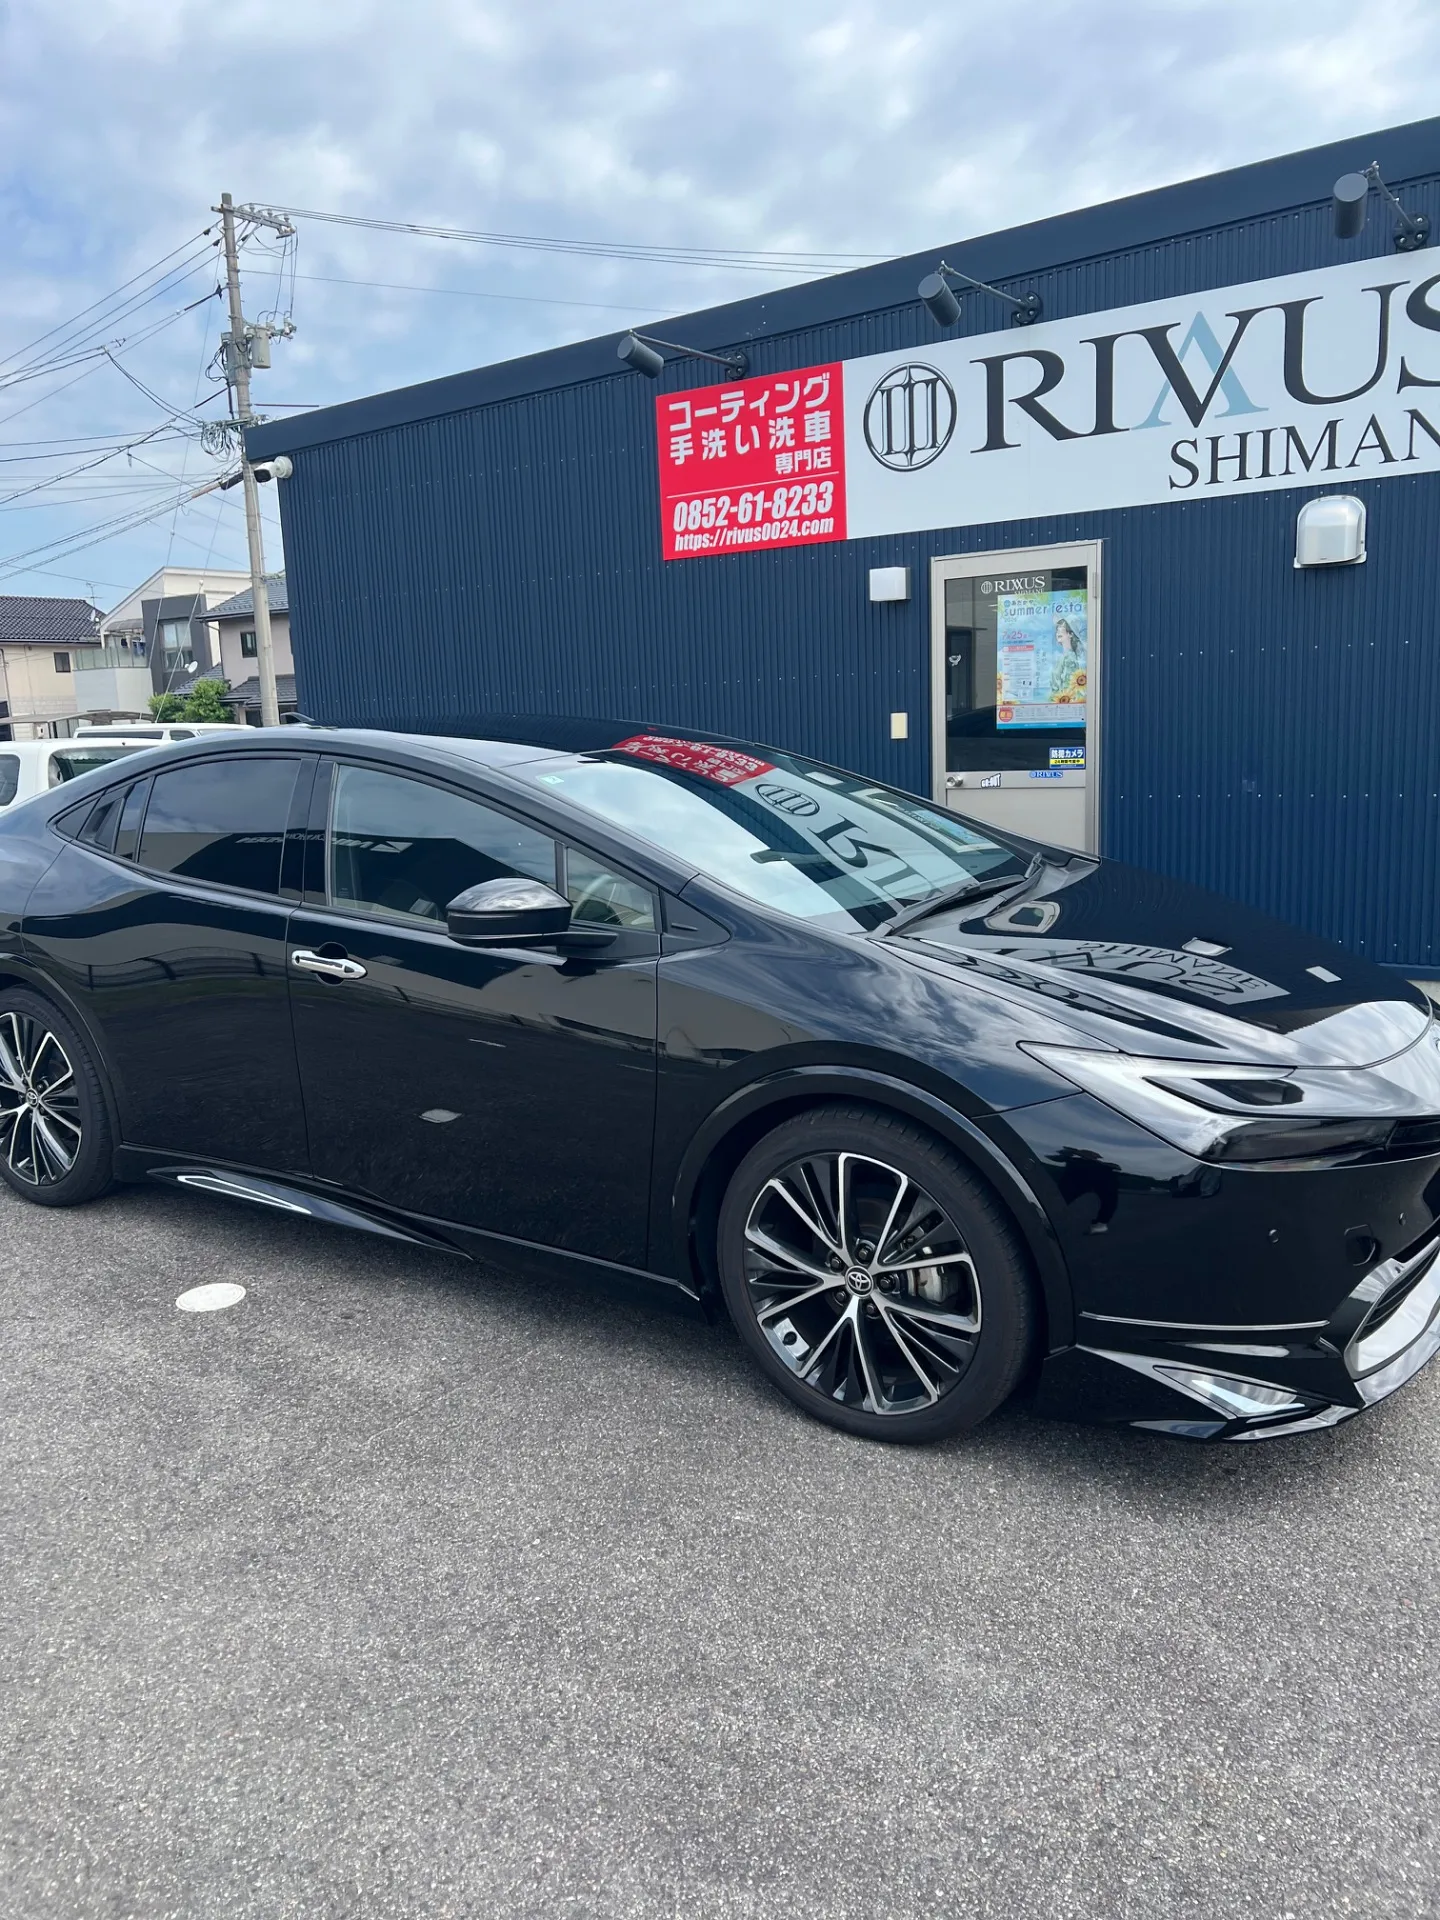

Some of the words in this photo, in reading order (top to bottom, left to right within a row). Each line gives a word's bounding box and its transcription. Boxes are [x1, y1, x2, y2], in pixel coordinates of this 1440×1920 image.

[669, 372, 830, 432] コーティング
[670, 410, 832, 465] 手洗い洗車
[775, 446, 832, 474] 専門店
[673, 480, 835, 532] 0852-61-8233
[675, 517, 834, 551] https://rivus0024.com
[1004, 605, 1048, 617] summer
[1052, 601, 1082, 613] festa
